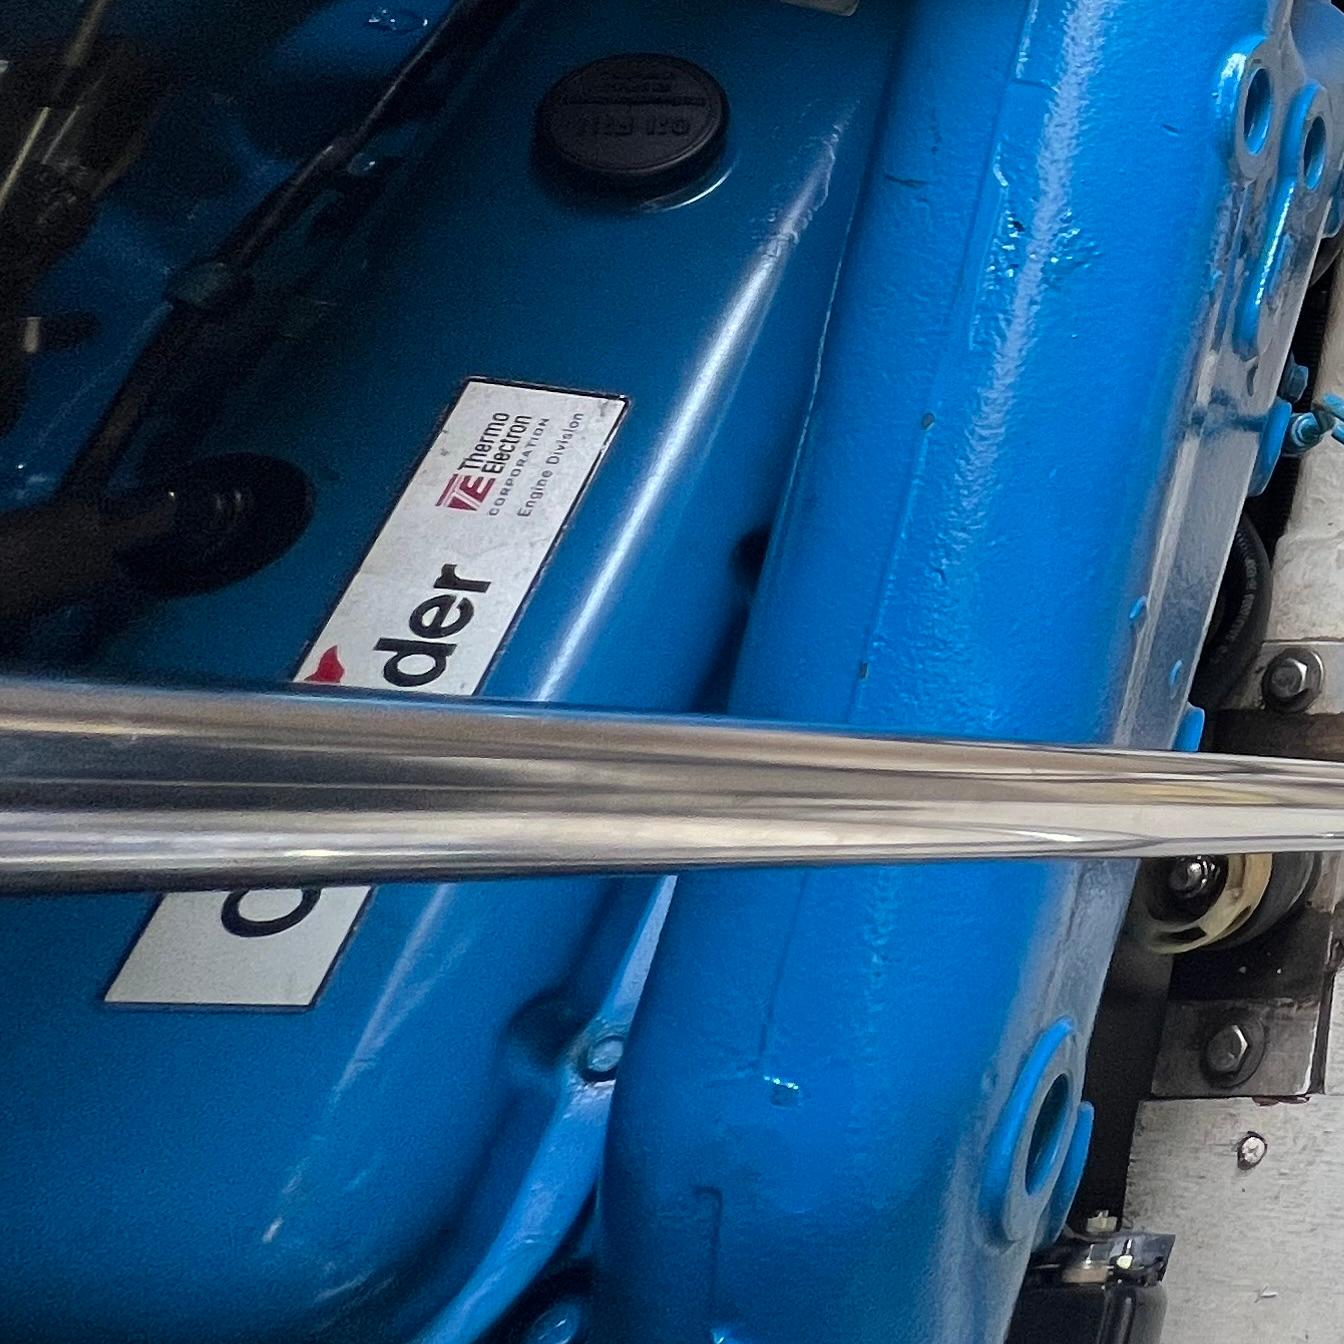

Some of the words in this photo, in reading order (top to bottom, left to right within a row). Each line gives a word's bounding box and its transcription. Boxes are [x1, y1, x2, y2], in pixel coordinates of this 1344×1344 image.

[457, 412, 511, 471] Thermo
[481, 415, 533, 474] Electron
[488, 418, 550, 516] CORPORATION
[517, 469, 554, 517] Engine
[545, 412, 585, 465] Division
